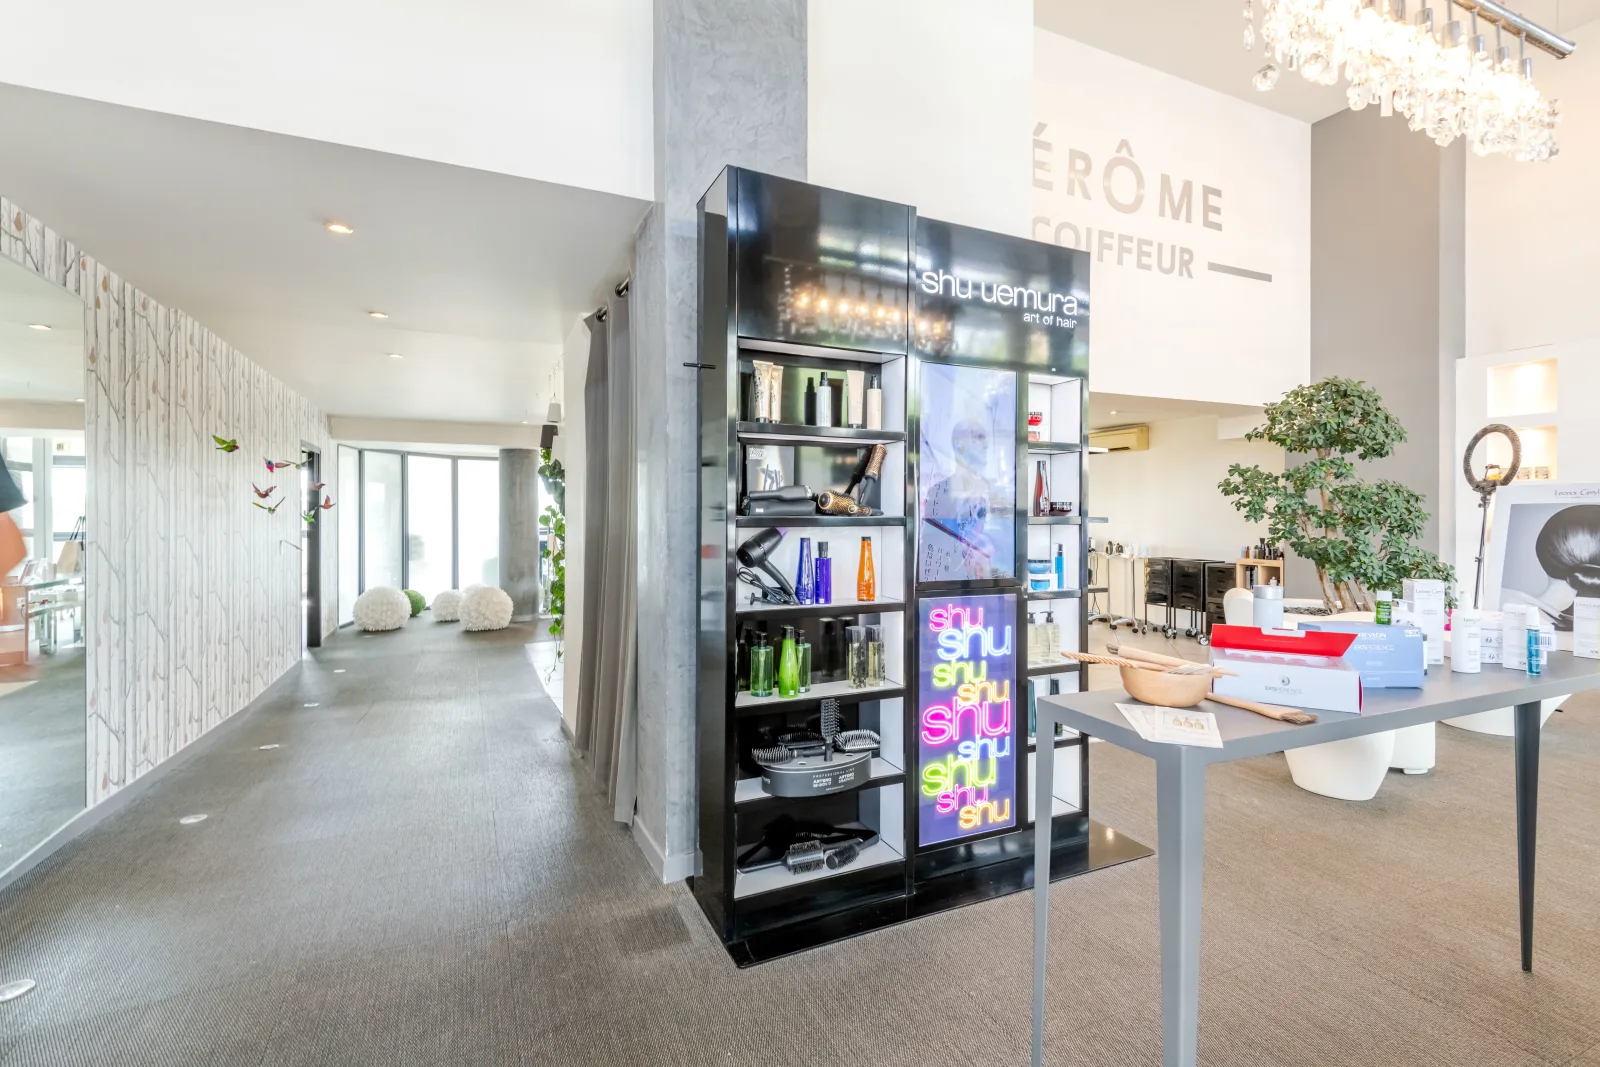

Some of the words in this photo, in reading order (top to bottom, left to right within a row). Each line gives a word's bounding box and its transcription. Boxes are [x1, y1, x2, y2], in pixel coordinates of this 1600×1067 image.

[921, 269, 972, 299] shu
[981, 281, 1078, 316] uemura
[1023, 312, 1040, 324] art
[1043, 316, 1054, 326] of
[1056, 316, 1077, 329] hair
[929, 604, 984, 632] shu
[937, 622, 1012, 660] shu
[933, 659, 987, 687] shu
[957, 680, 1010, 705] shu
[922, 696, 1011, 744] shu
[958, 735, 1010, 761] shu
[922, 753, 996, 796] shu
[936, 784, 988, 813] shu
[959, 799, 1010, 829] shu
